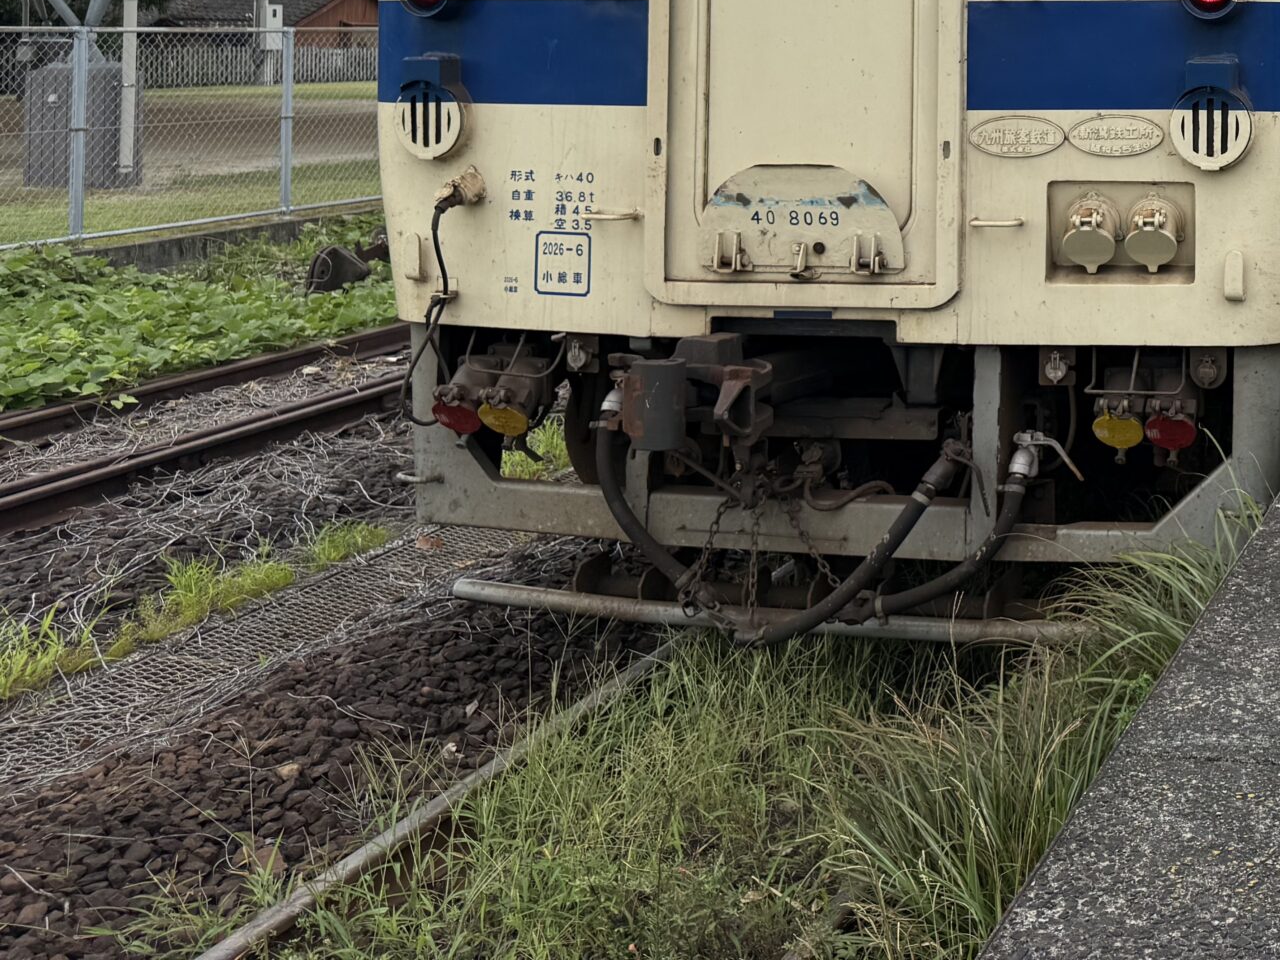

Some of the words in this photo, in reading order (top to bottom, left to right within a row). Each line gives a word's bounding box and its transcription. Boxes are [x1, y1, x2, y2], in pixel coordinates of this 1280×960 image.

[510, 170, 536, 182] 形式
[511, 189, 536, 201] 自重
[750, 210, 776, 225] 40
[788, 210, 840, 227] 8069
[542, 242, 583, 256] 2026-6
